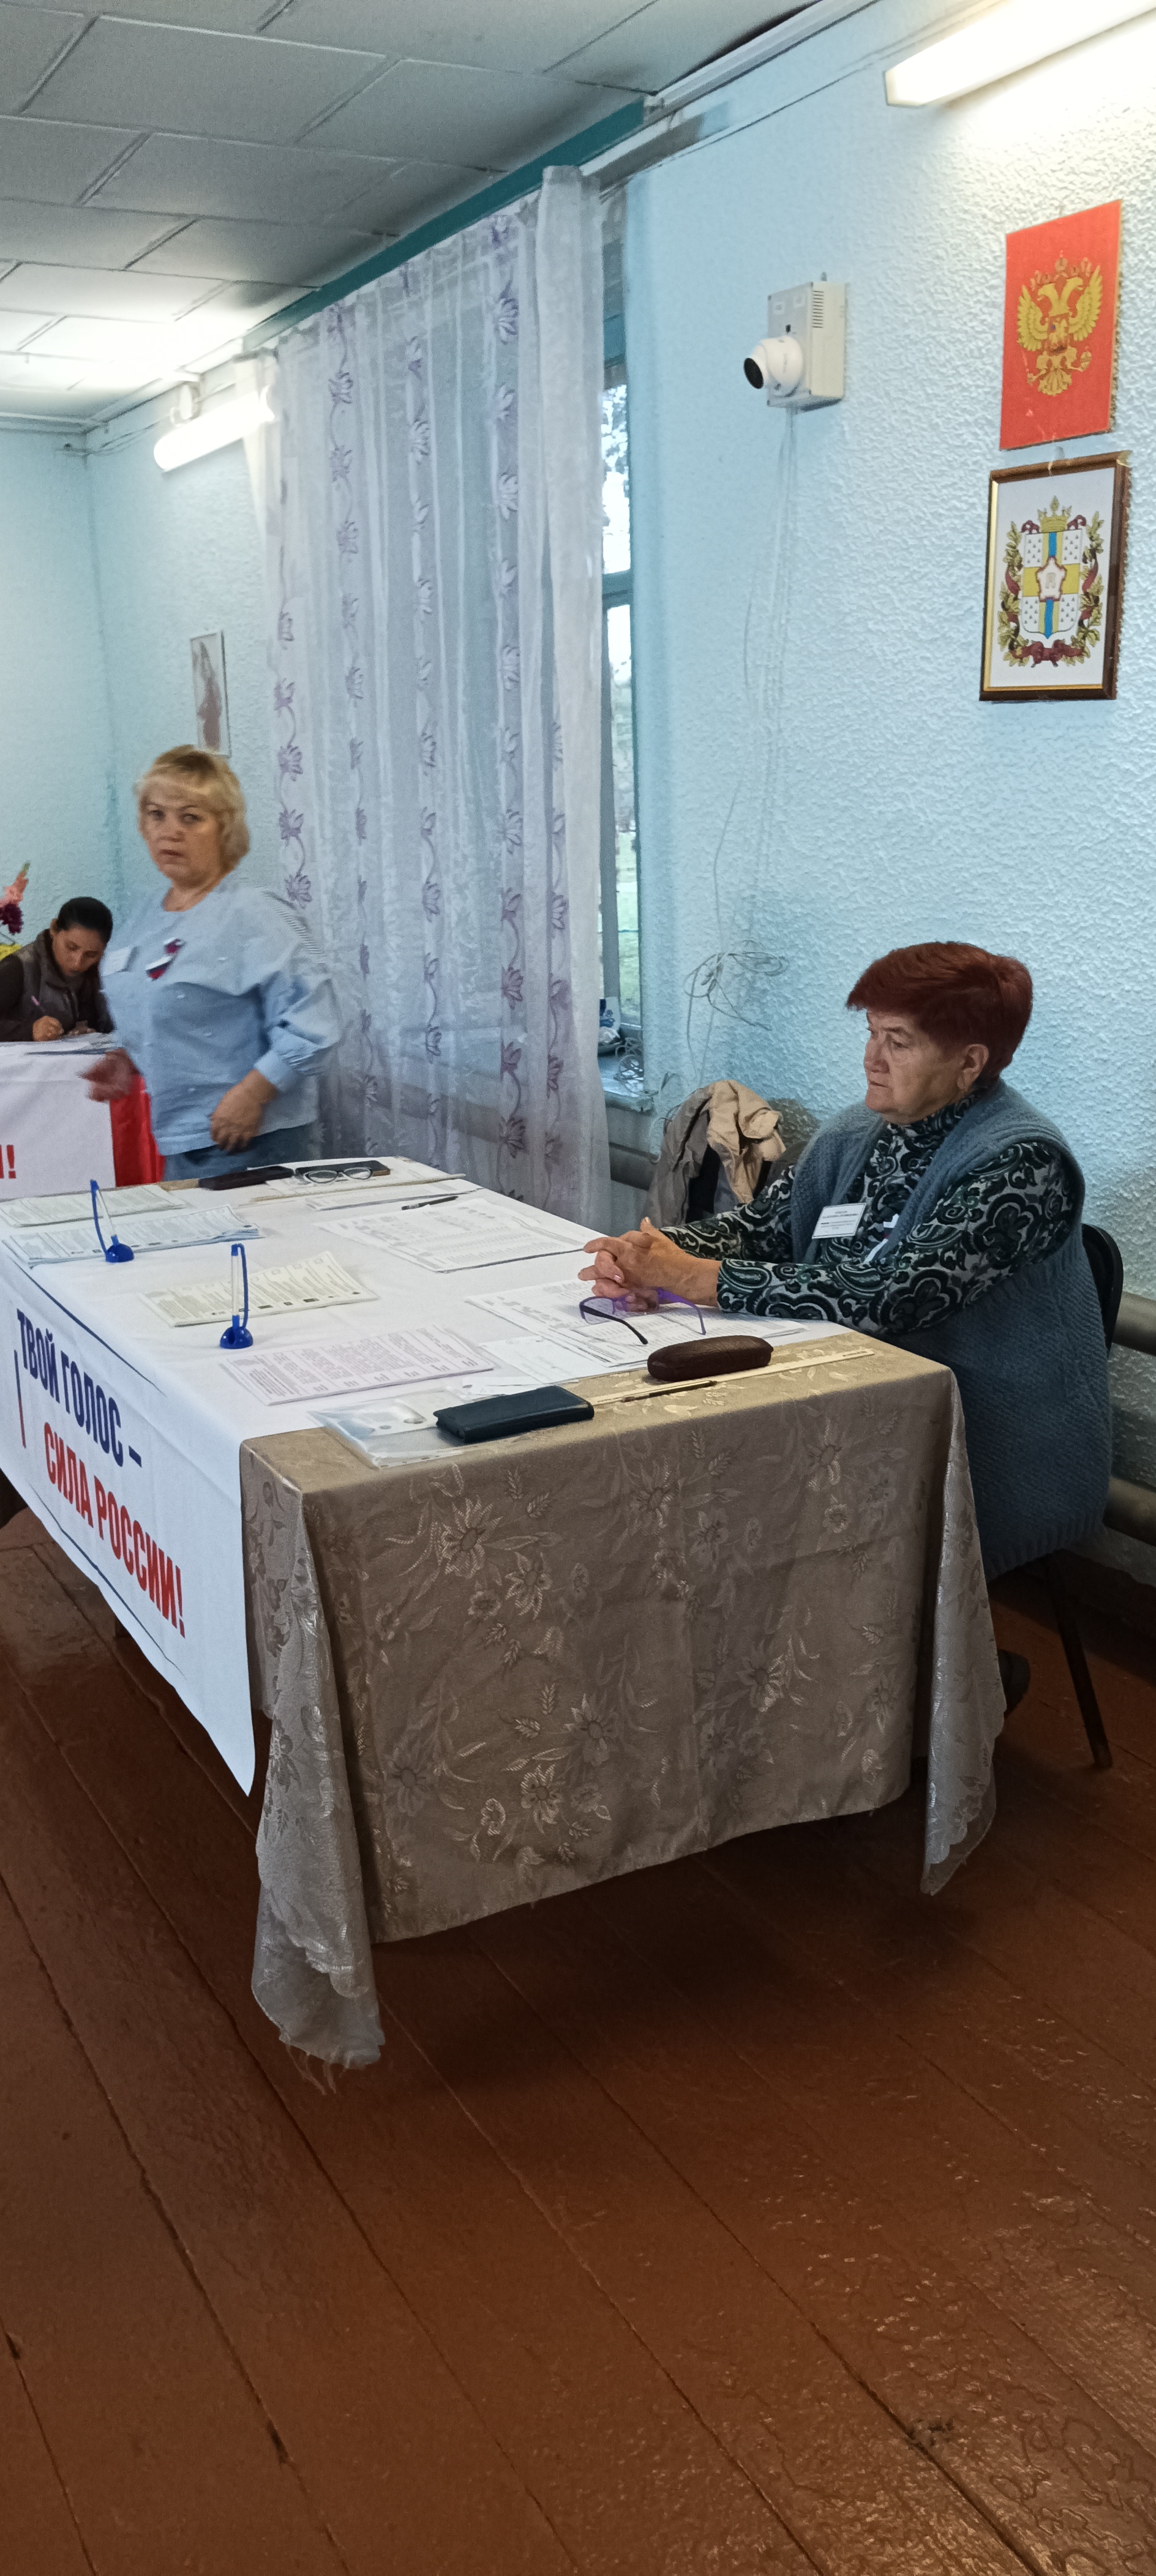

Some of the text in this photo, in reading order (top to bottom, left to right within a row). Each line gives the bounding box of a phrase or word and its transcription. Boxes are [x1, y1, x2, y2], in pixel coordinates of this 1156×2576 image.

[17, 1308, 60, 1404] ТВОЙ
[61, 1350, 124, 1467] ГОЛОС
[44, 1422, 185, 1639] СИЛА РОССИИ!
